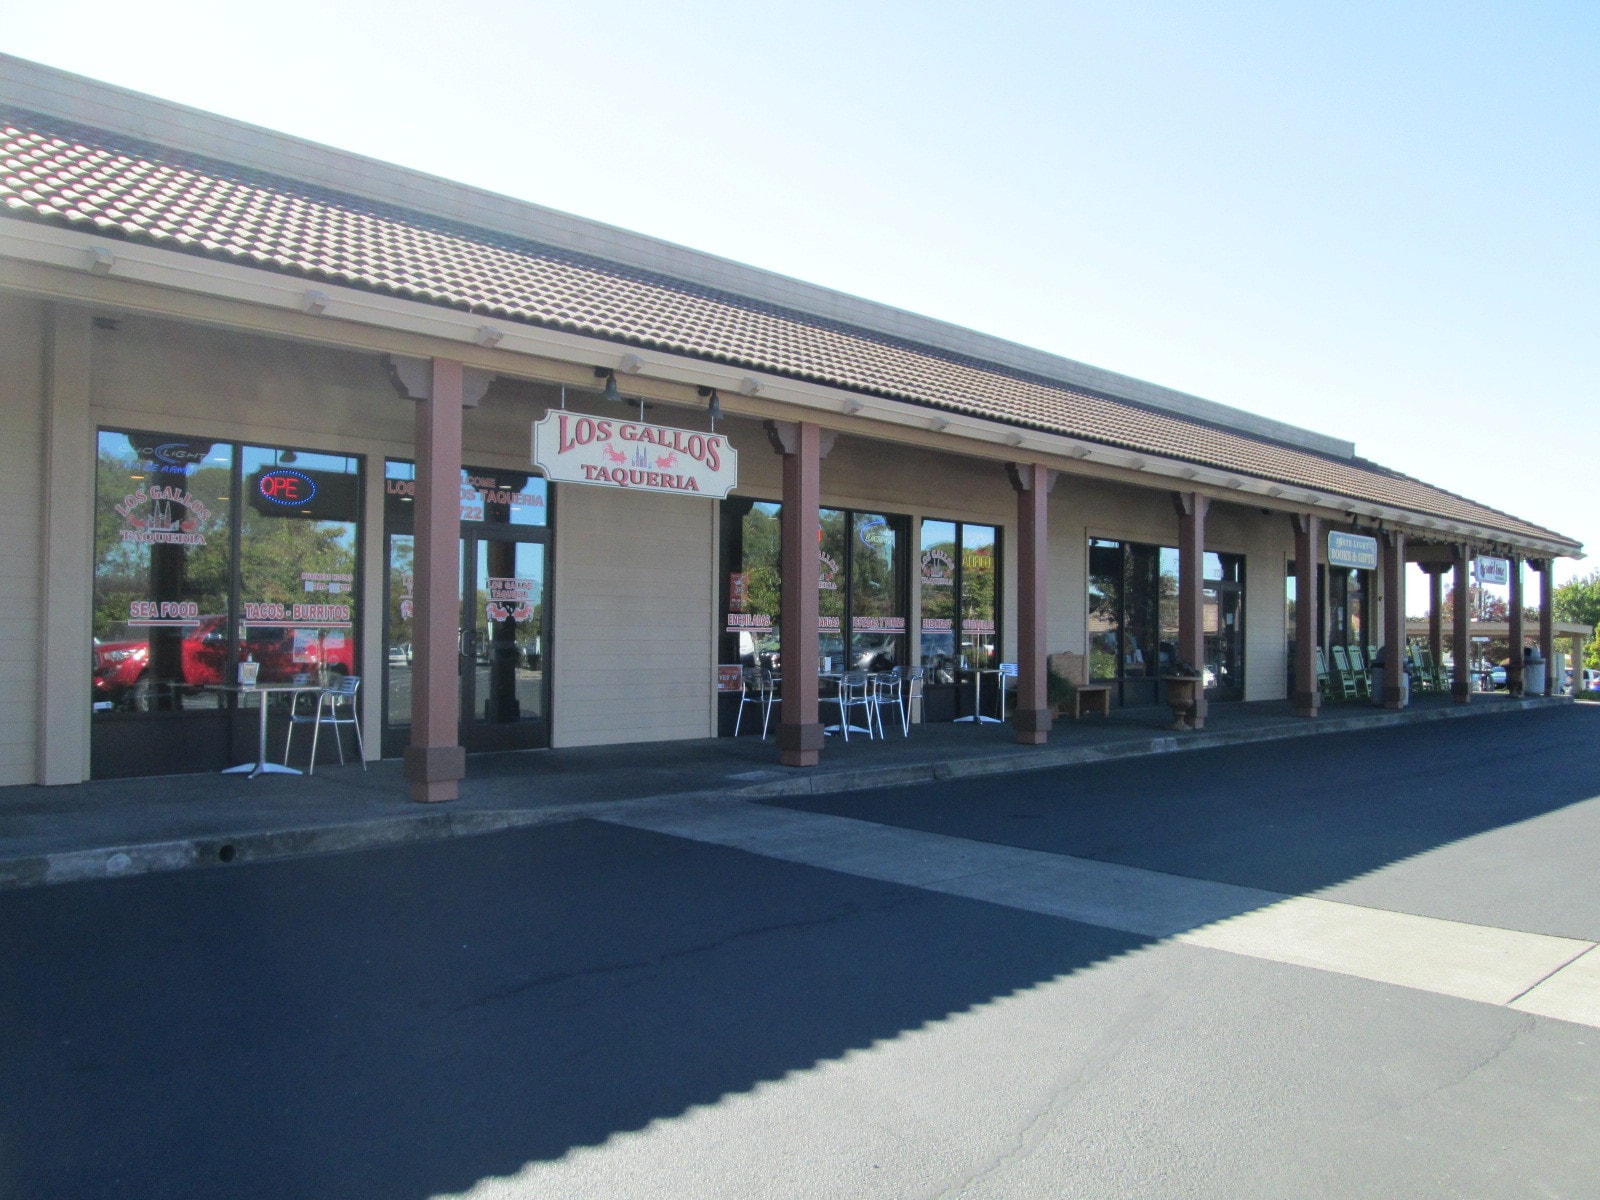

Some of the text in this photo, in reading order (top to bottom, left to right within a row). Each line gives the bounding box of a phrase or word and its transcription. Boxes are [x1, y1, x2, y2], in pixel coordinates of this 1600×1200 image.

[558, 415, 721, 472] LOS GALLOS
[163, 448, 207, 458] LIGHT
[581, 464, 699, 491] TAQUERIA
[114, 485, 212, 521] LOS GALLOS
[479, 488, 544, 507] TAQUERIA
[120, 529, 207, 545] TAQUERIA
[962, 555, 991, 569] ACIFICO
[130, 602, 198, 617] SEA FOOD
[244, 603, 284, 620] TACOS
[293, 603, 349, 620] BURRITOS
[728, 614, 771, 626] ENCHILADAS
